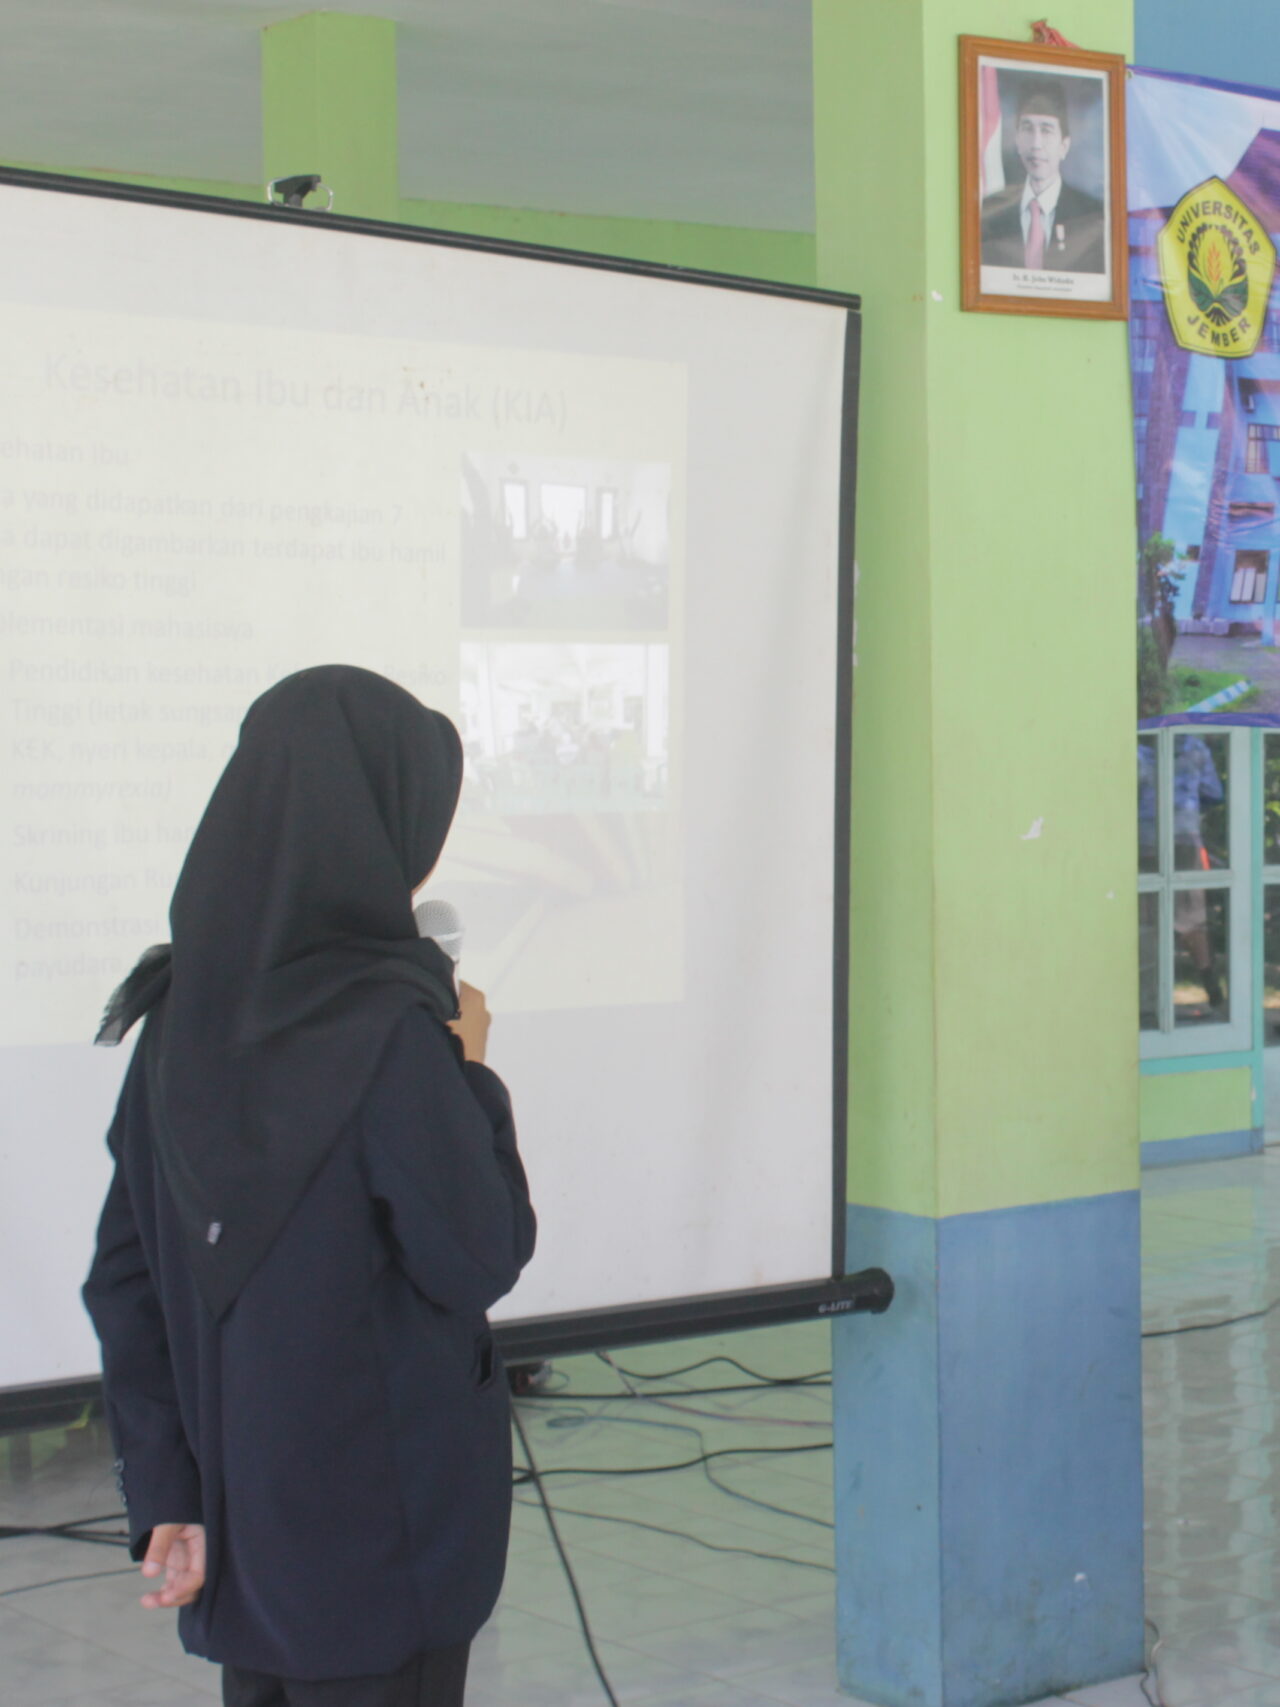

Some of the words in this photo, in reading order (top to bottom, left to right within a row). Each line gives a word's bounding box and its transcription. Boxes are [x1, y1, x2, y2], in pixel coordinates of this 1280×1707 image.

[1177, 200, 1260, 256] UNIVERSITAS
[1187, 313, 1251, 348] JEMBER
[44, 352, 242, 404] Kesehatan
[255, 371, 309, 409] Ibu
[323, 371, 386, 415] dan
[399, 377, 481, 421] Anak
[491, 388, 568, 434] (KIA)
[22, 488, 78, 515] yang
[24, 525, 91, 556] dapat
[253, 536, 344, 565] terdapat
[133, 568, 197, 599] tinggi
[9, 657, 139, 685] Pendidikan
[146, 659, 261, 687] kesehatan
[12, 697, 82, 728] Tinggi
[13, 822, 108, 852] Skrining
[13, 870, 137, 897] Kunjungan
